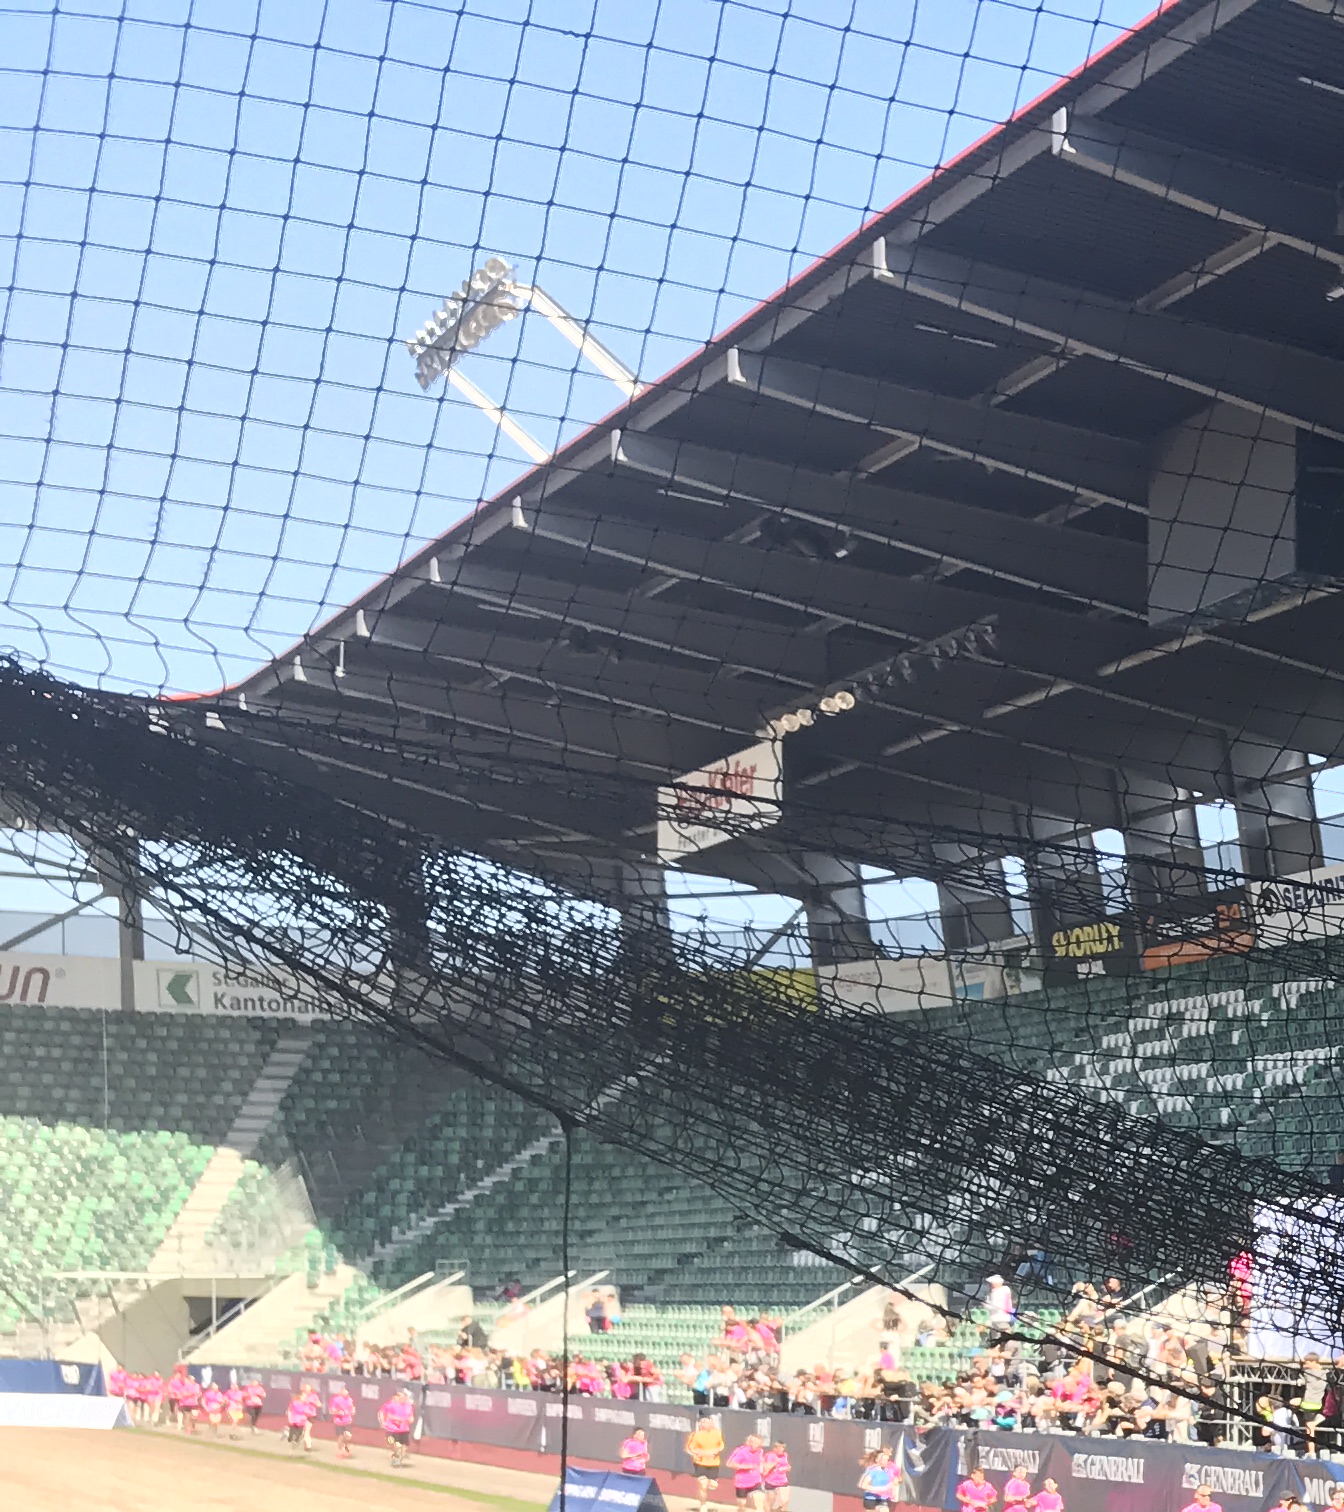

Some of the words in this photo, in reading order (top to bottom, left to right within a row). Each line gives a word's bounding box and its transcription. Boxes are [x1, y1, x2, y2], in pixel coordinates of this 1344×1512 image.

[989, 1446, 1039, 1474] GENERALI
[1086, 1455, 1145, 1483] GENERALI
[1200, 1466, 1264, 1498] GENERALI
